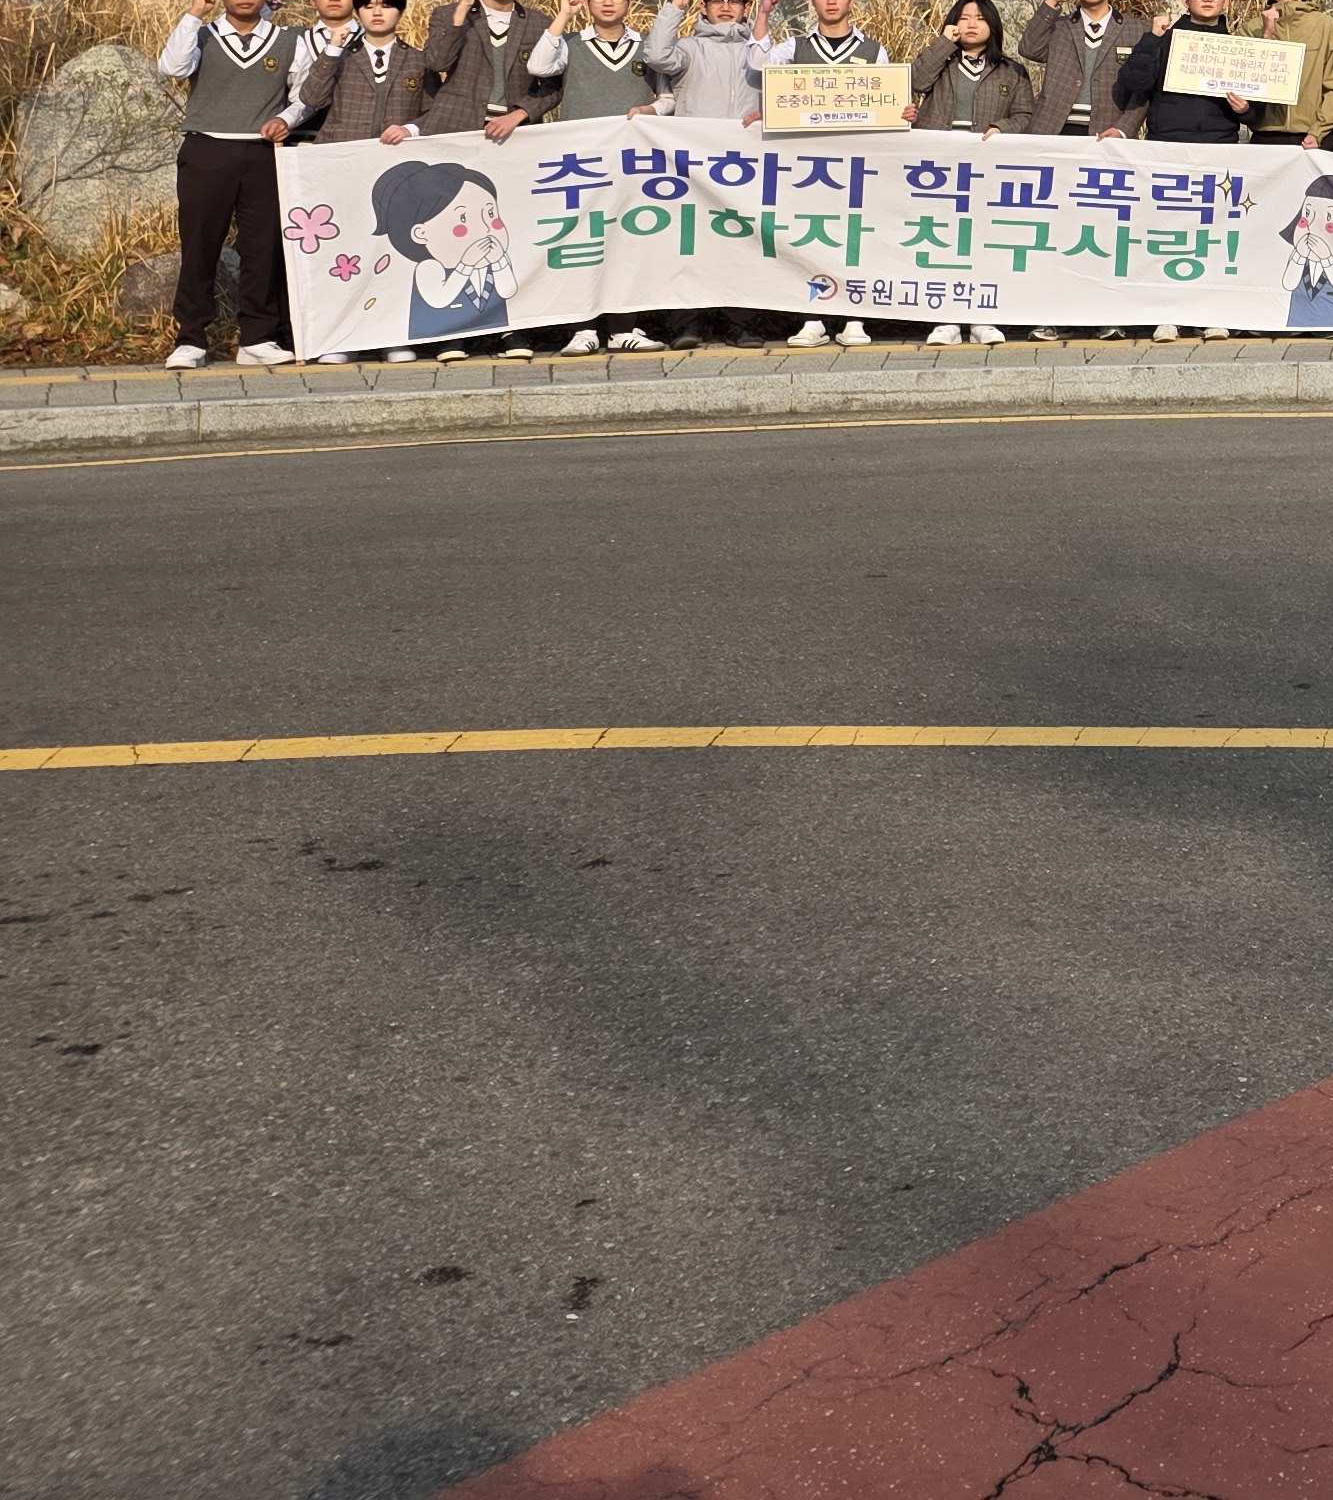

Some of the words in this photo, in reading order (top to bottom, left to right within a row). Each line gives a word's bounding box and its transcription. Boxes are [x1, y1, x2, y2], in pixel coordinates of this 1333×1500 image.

[1181, 52, 1227, 66] 괴롭히거나
[1230, 57, 1266, 71] 따돌리지
[1270, 61, 1291, 74] 않고,
[1202, 43, 1256, 58] 장난으로라도
[1260, 50, 1287, 61] 친구를
[813, 76, 838, 91] 학교
[844, 76, 882, 90] 규칙을
[1180, 64, 1224, 79] 학교폭력을
[1228, 69, 1246, 81] 하지
[1250, 71, 1288, 86] 않습니다.
[775, 93, 827, 108] 존중하고
[832, 93, 900, 108] 준수합니다.
[824, 112, 869, 120] 동원고등학교
[530, 147, 879, 210] 추방하자
[902, 159, 1244, 226] 학교폭력!
[532, 203, 876, 270] 같이하자
[898, 215, 1241, 282] 친구사랑!
[845, 278, 999, 311] 동원고등학교
